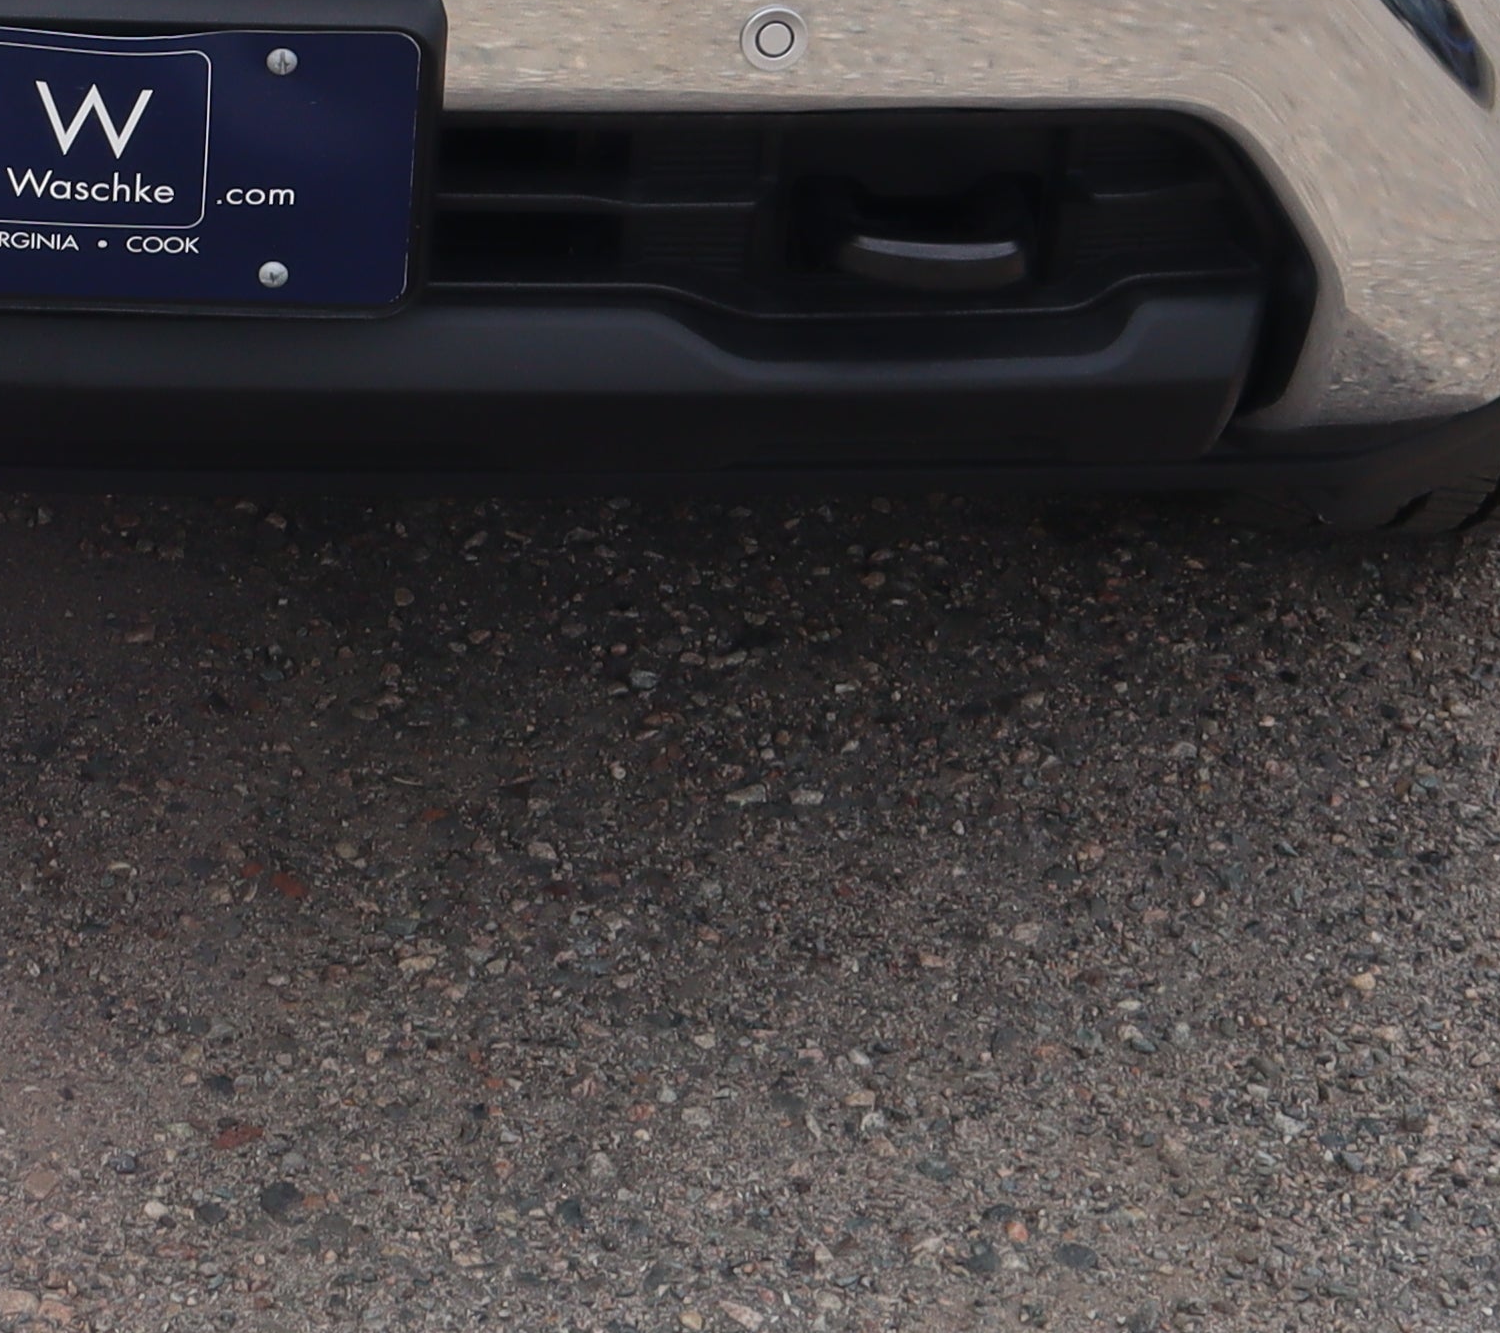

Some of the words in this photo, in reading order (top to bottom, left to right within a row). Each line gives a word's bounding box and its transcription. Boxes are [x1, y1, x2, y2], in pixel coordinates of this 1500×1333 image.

[35, 80, 154, 159] W
[6, 167, 175, 204] Waschke
[216, 183, 295, 206] .com
[126, 236, 200, 254] COOK
